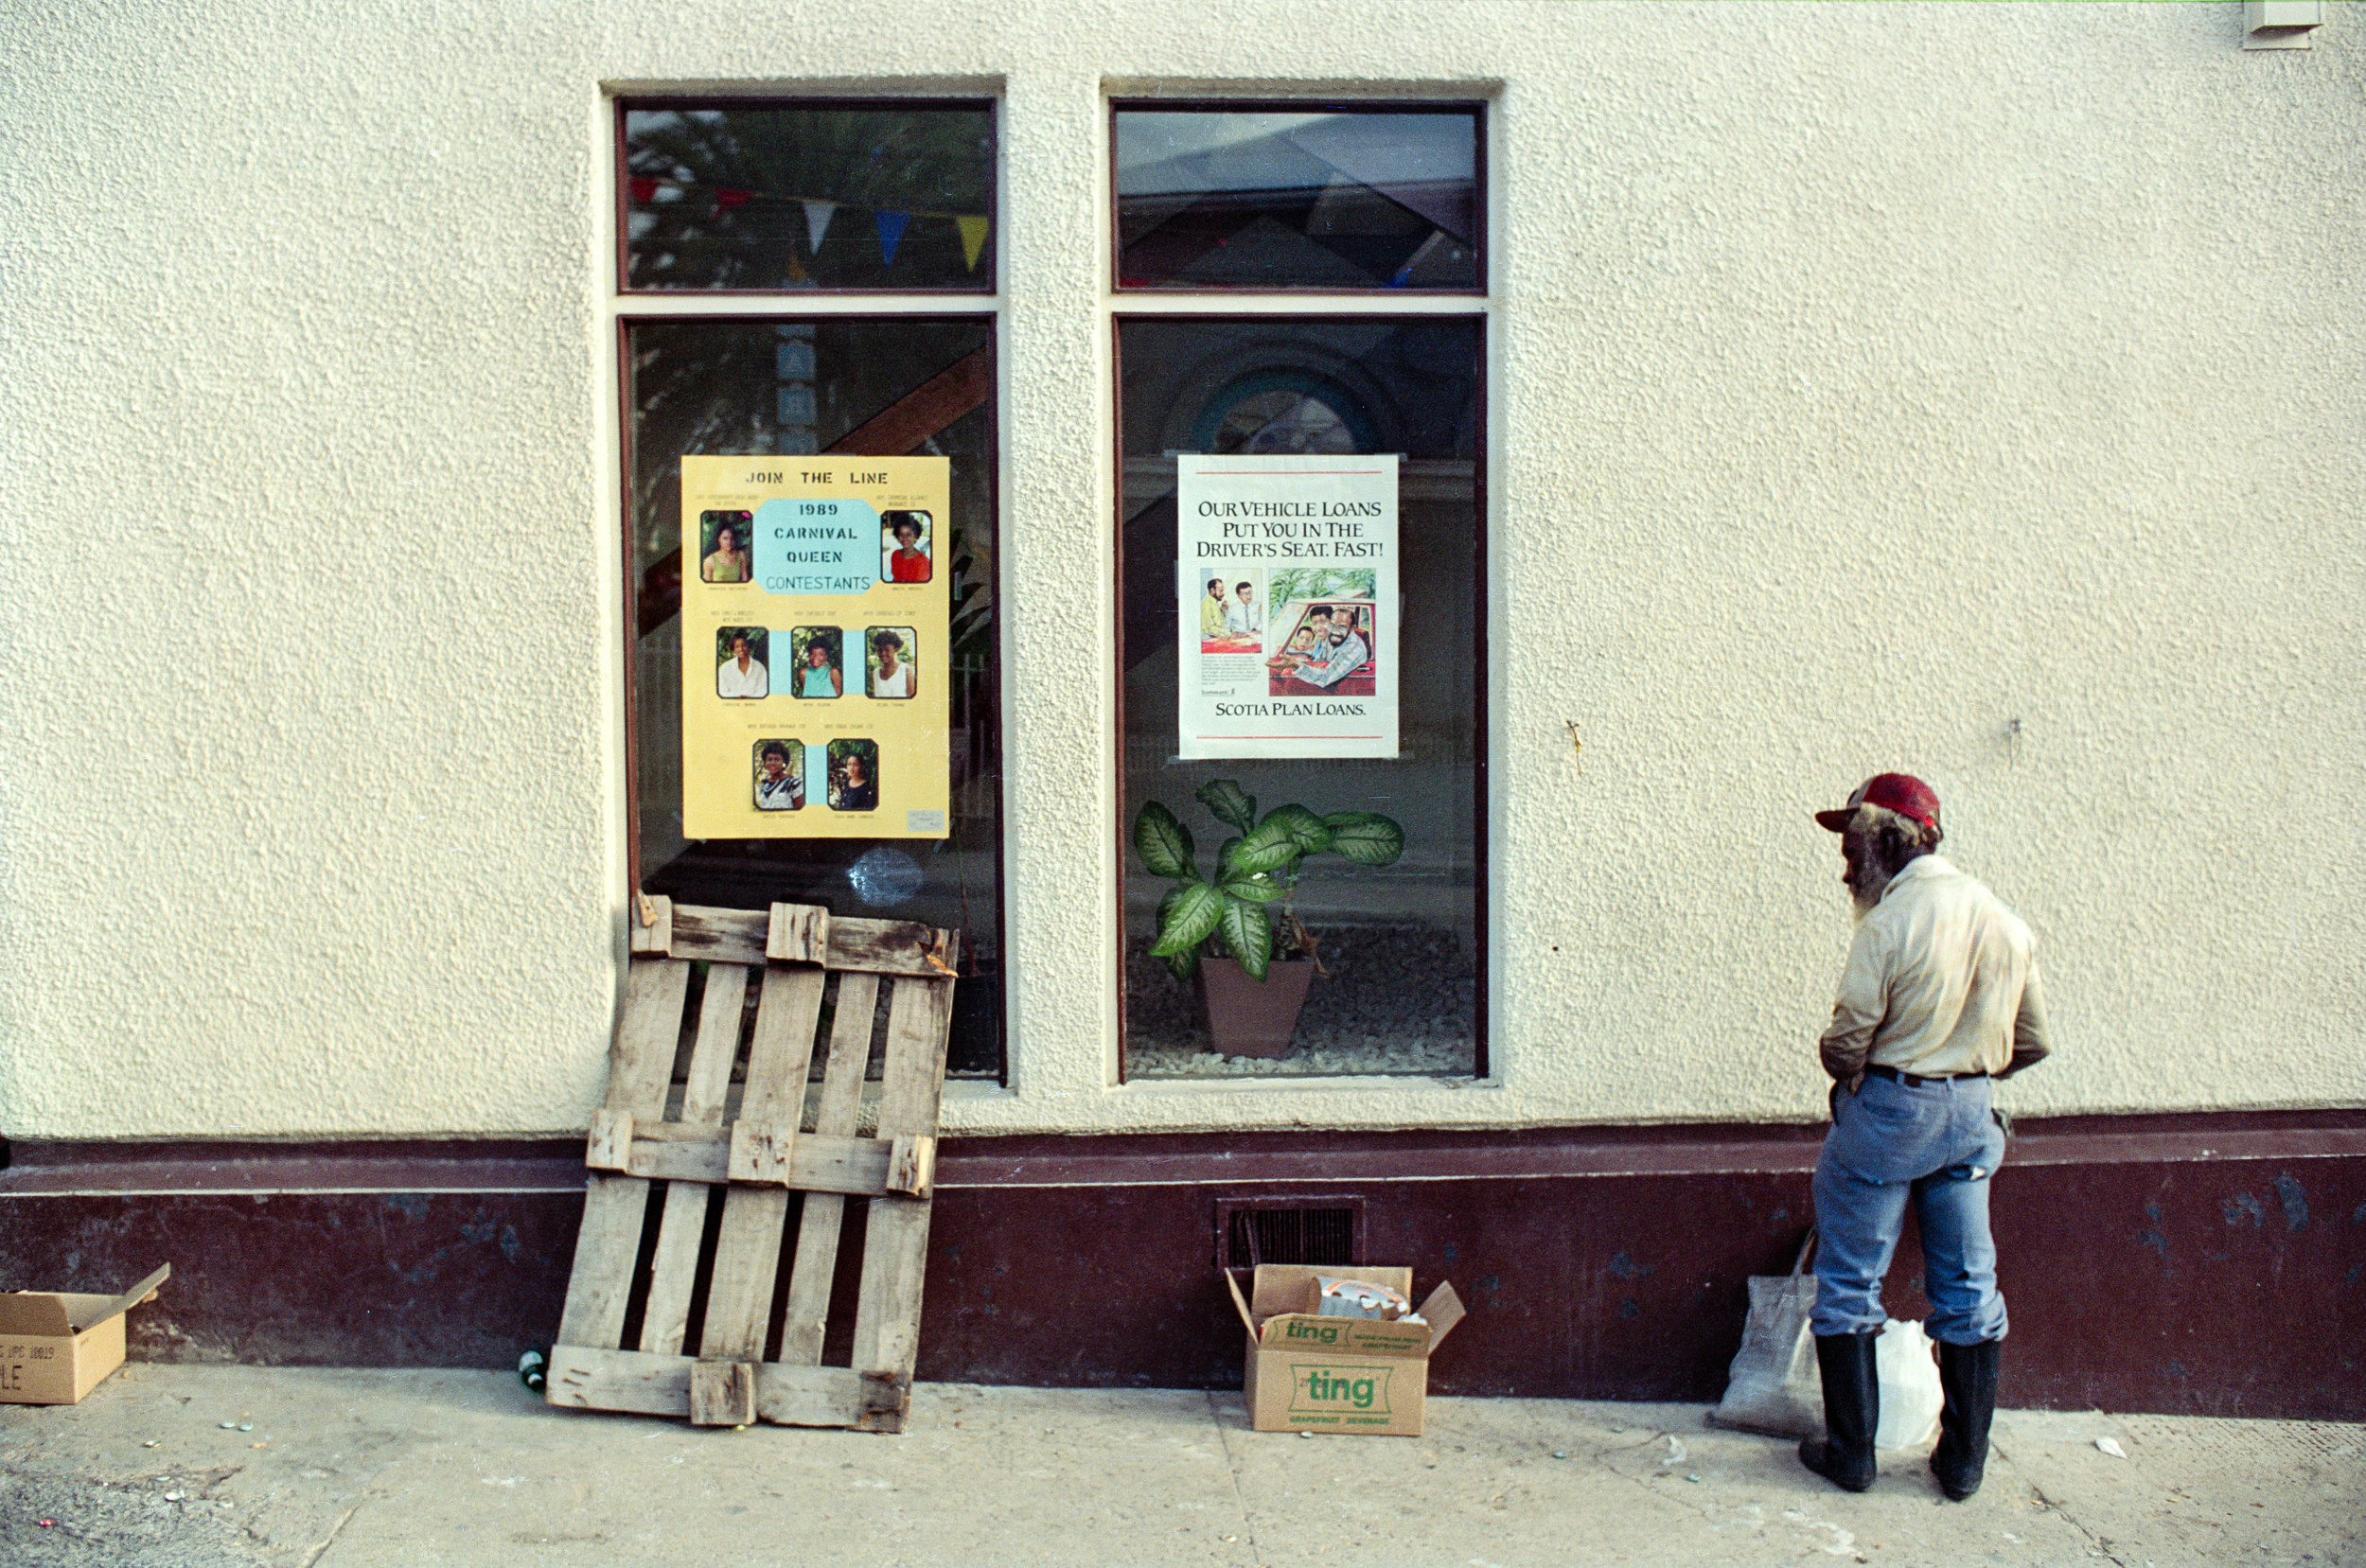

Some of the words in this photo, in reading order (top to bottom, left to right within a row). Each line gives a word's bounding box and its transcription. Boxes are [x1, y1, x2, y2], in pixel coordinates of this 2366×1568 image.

[746, 472, 784, 484] JOIN
[801, 472, 833, 484] THE
[850, 472, 888, 484] LINE
[800, 503, 839, 516] 1989
[1197, 501, 1236, 518] OUR
[1239, 501, 1316, 518] VEHICLE
[1322, 502, 1382, 518] LOANS
[773, 527, 858, 539] CARNIVAL
[1223, 522, 1258, 538] PUT
[1261, 522, 1298, 538] YOU
[1302, 522, 1321, 537] IN
[1325, 522, 1363, 537] THE
[1197, 541, 1277, 557] DRIVER'S
[1281, 541, 1330, 557] SEAT.
[1334, 541, 1384, 557] FAST!
[786, 551, 842, 563] QUEEN
[767, 575, 871, 590] CONTESTANTS
[1215, 702, 1269, 716] SCOTIA
[1272, 702, 1313, 716] PLAN
[1315, 702, 1367, 716] LOANS.
[1287, 1321, 1338, 1344] ting
[0, 1365, 23, 1390] LE
[1309, 1370, 1374, 1409] ting
